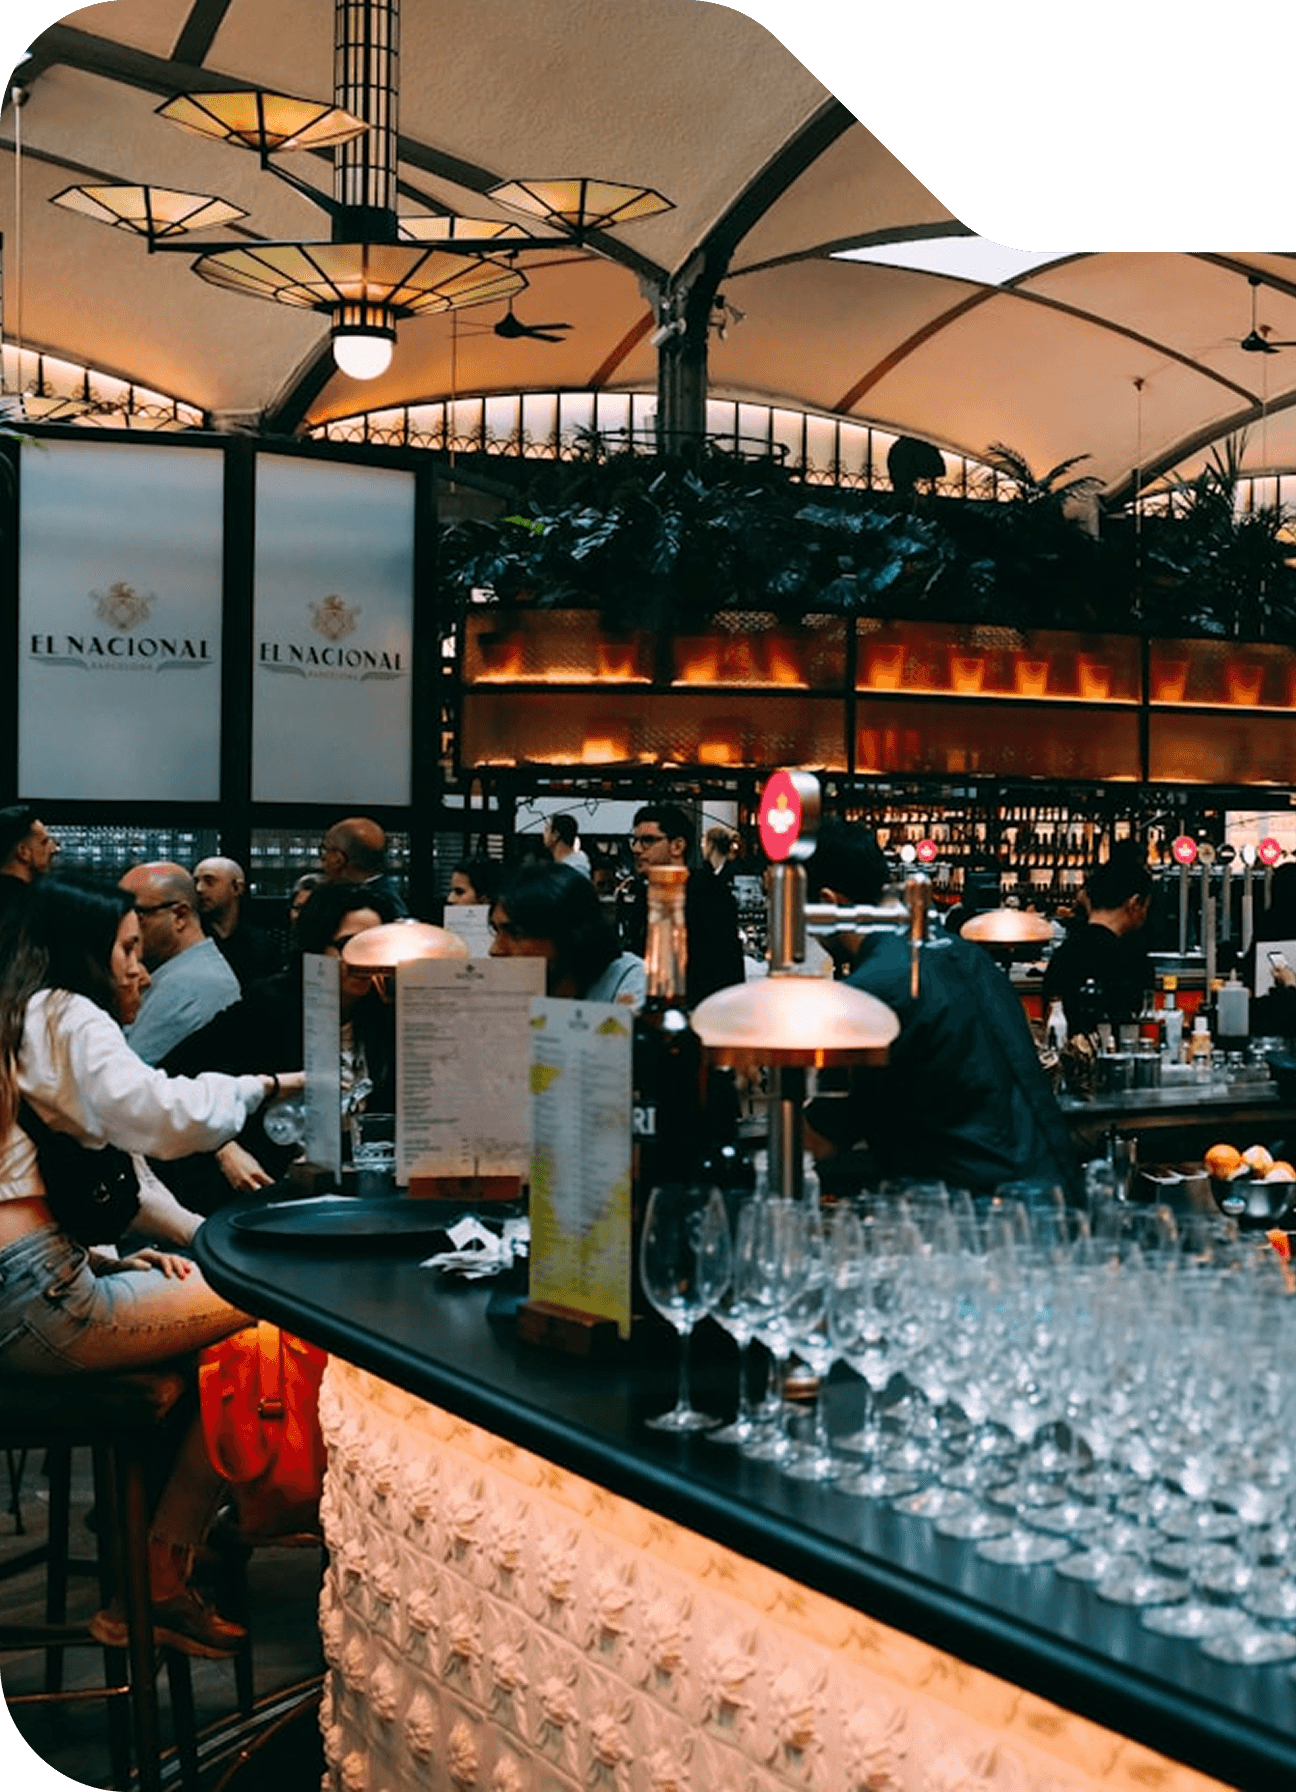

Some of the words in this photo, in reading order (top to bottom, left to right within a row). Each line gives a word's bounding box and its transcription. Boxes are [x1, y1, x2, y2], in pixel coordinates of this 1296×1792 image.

[31, 634, 58, 655] EL
[67, 635, 212, 659] NACIONAL
[260, 642, 282, 662] EL
[288, 644, 405, 671] NACIONAL
